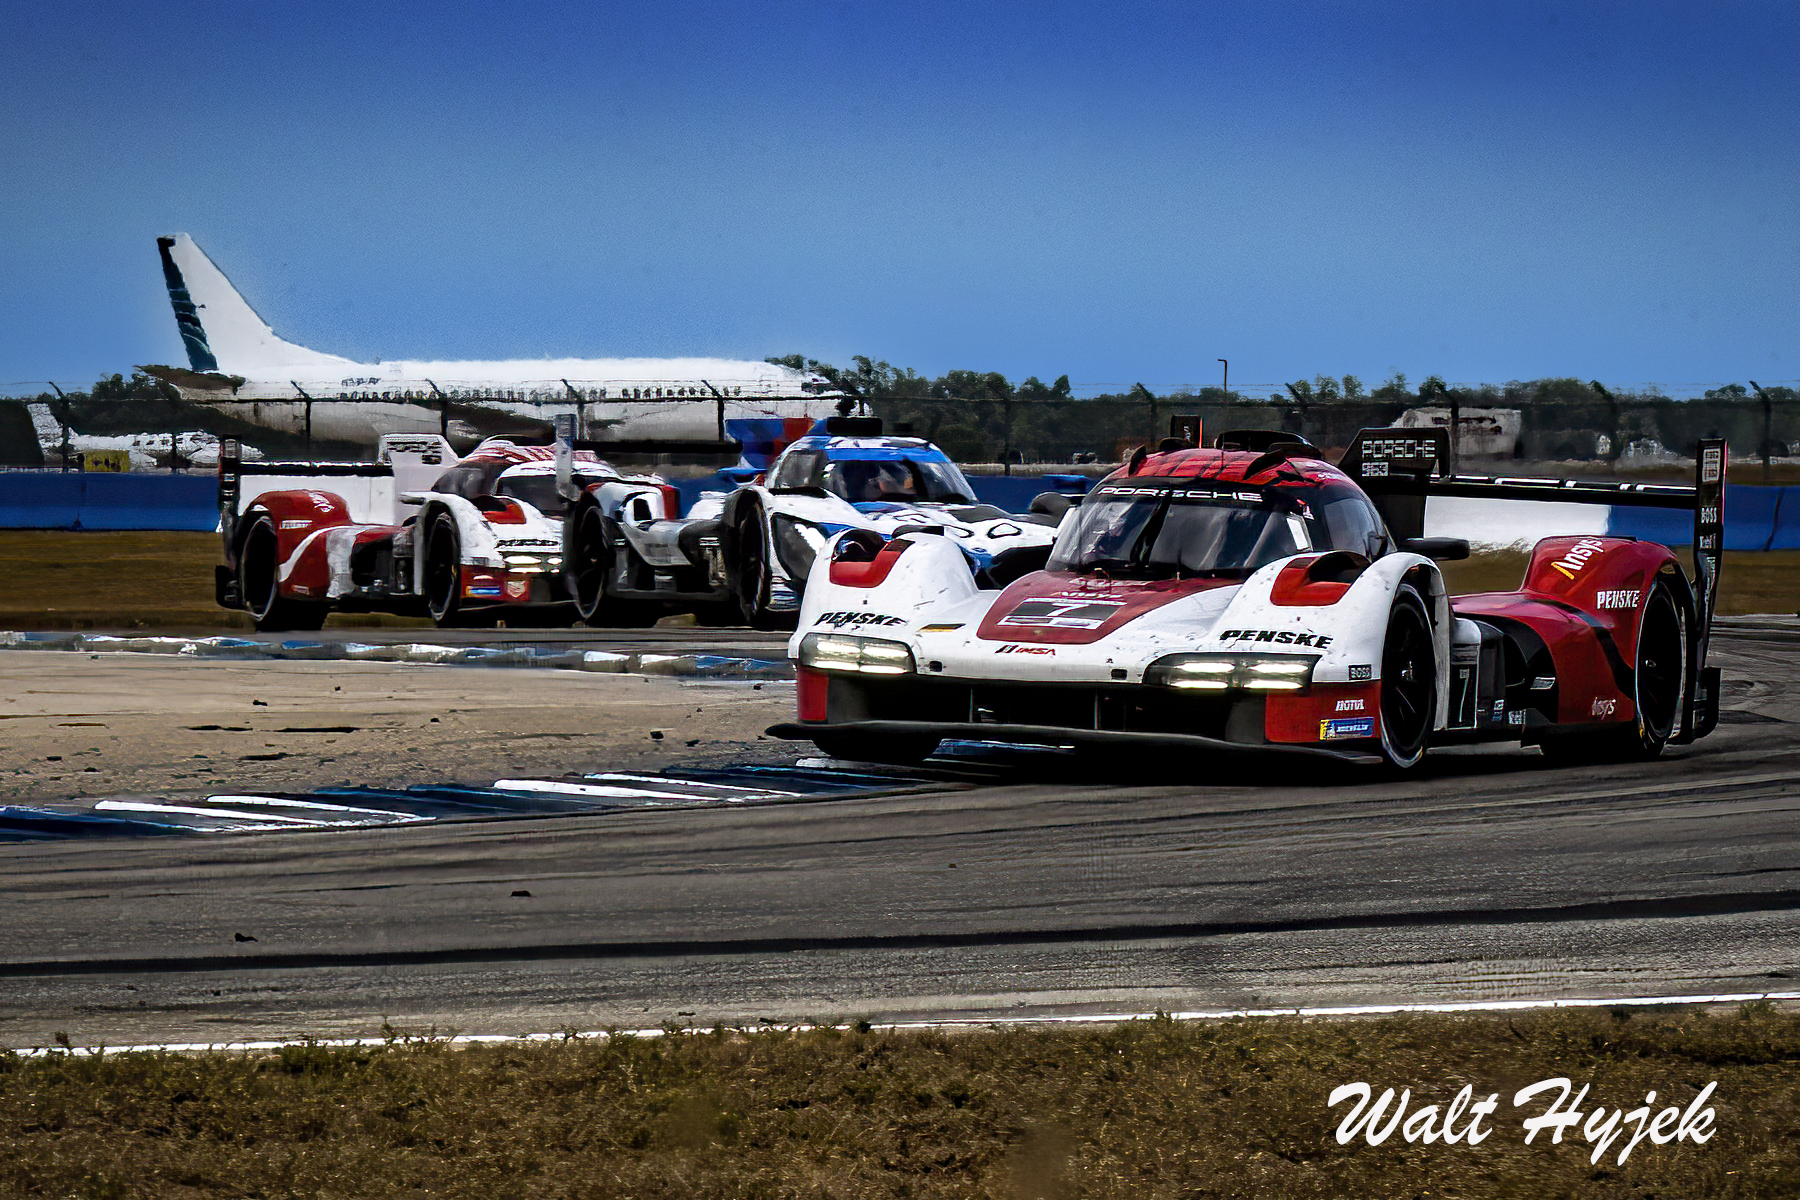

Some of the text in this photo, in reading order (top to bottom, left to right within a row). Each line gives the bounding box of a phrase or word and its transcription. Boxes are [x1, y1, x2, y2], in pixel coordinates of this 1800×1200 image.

[1362, 439, 1436, 458] PORSCHE
[1097, 486, 1264, 503] PORSCHE
[1700, 507, 1718, 524] BOSS
[1596, 589, 1641, 610] PENSKE
[1046, 602, 1092, 617] 7
[812, 611, 908, 627] PENSKE
[1219, 629, 1334, 649] PENSKE
